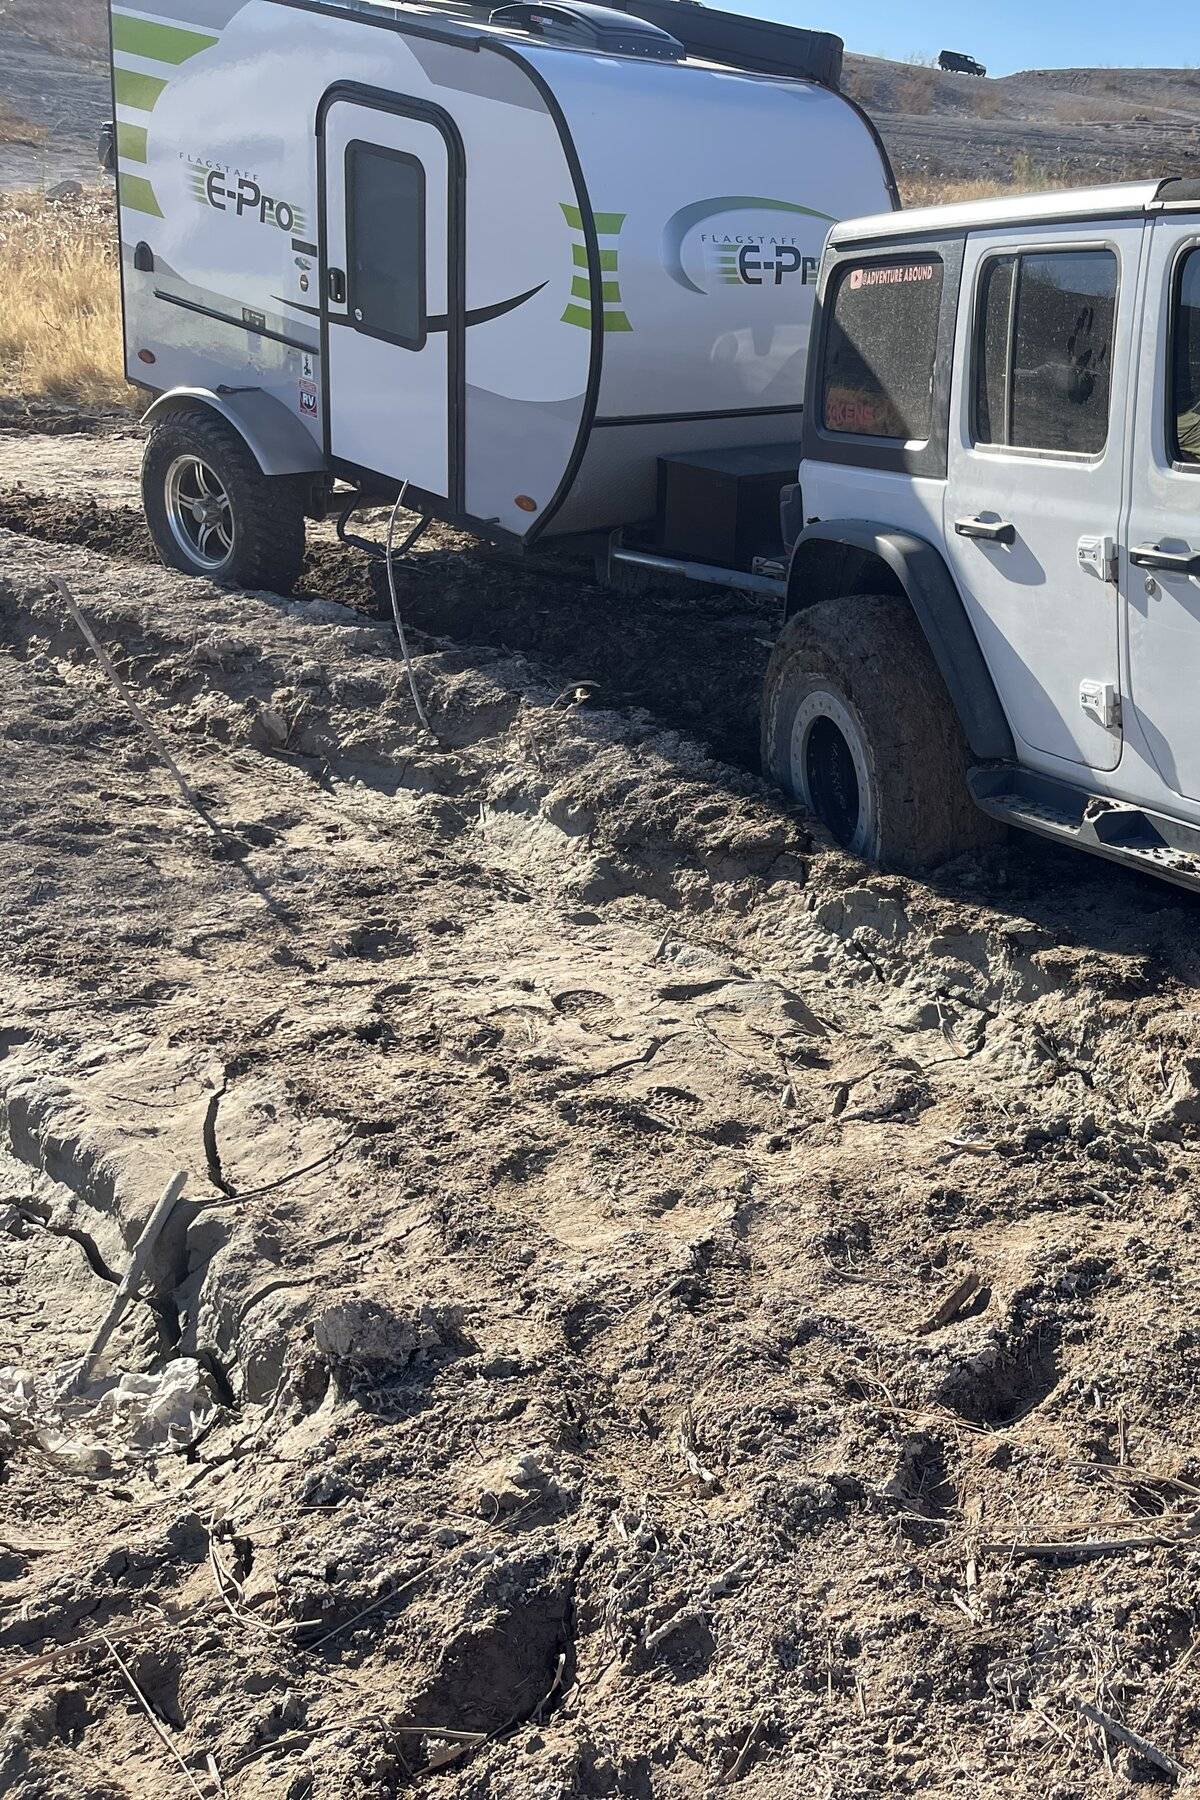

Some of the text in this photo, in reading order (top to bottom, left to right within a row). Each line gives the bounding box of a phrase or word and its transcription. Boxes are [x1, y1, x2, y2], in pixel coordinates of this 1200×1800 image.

[179, 151, 261, 182] FLAGSTAFF
[700, 233, 799, 246] FLAGSTAFF
[738, 244, 820, 286] E-Pr
[302, 391, 316, 407] RV
